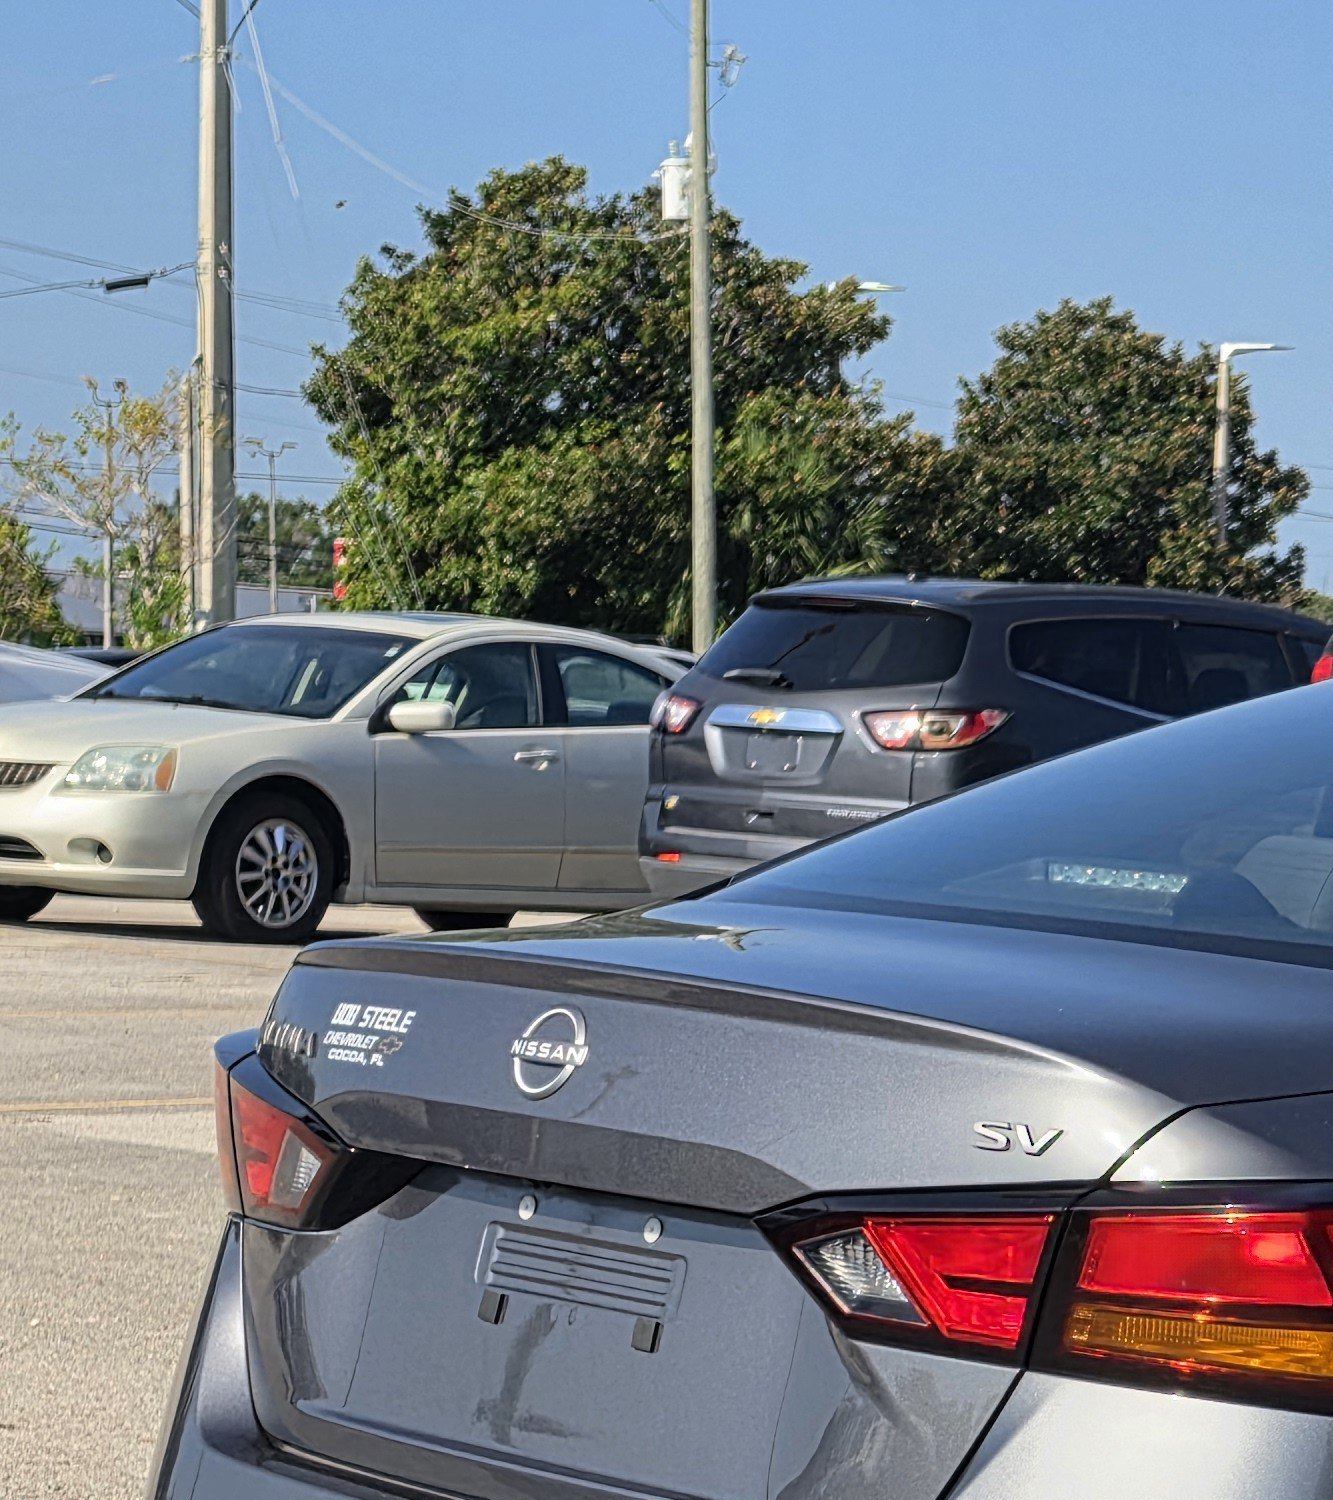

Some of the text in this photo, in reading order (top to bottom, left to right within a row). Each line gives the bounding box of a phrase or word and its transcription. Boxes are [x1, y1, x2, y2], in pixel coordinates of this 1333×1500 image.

[358, 1005, 417, 1034] STEELE
[322, 1030, 380, 1050] CHEVROLET
[510, 1039, 587, 1064] NISSAN
[327, 1048, 385, 1067] COCOA, FL
[972, 1121, 1065, 1157] SV
